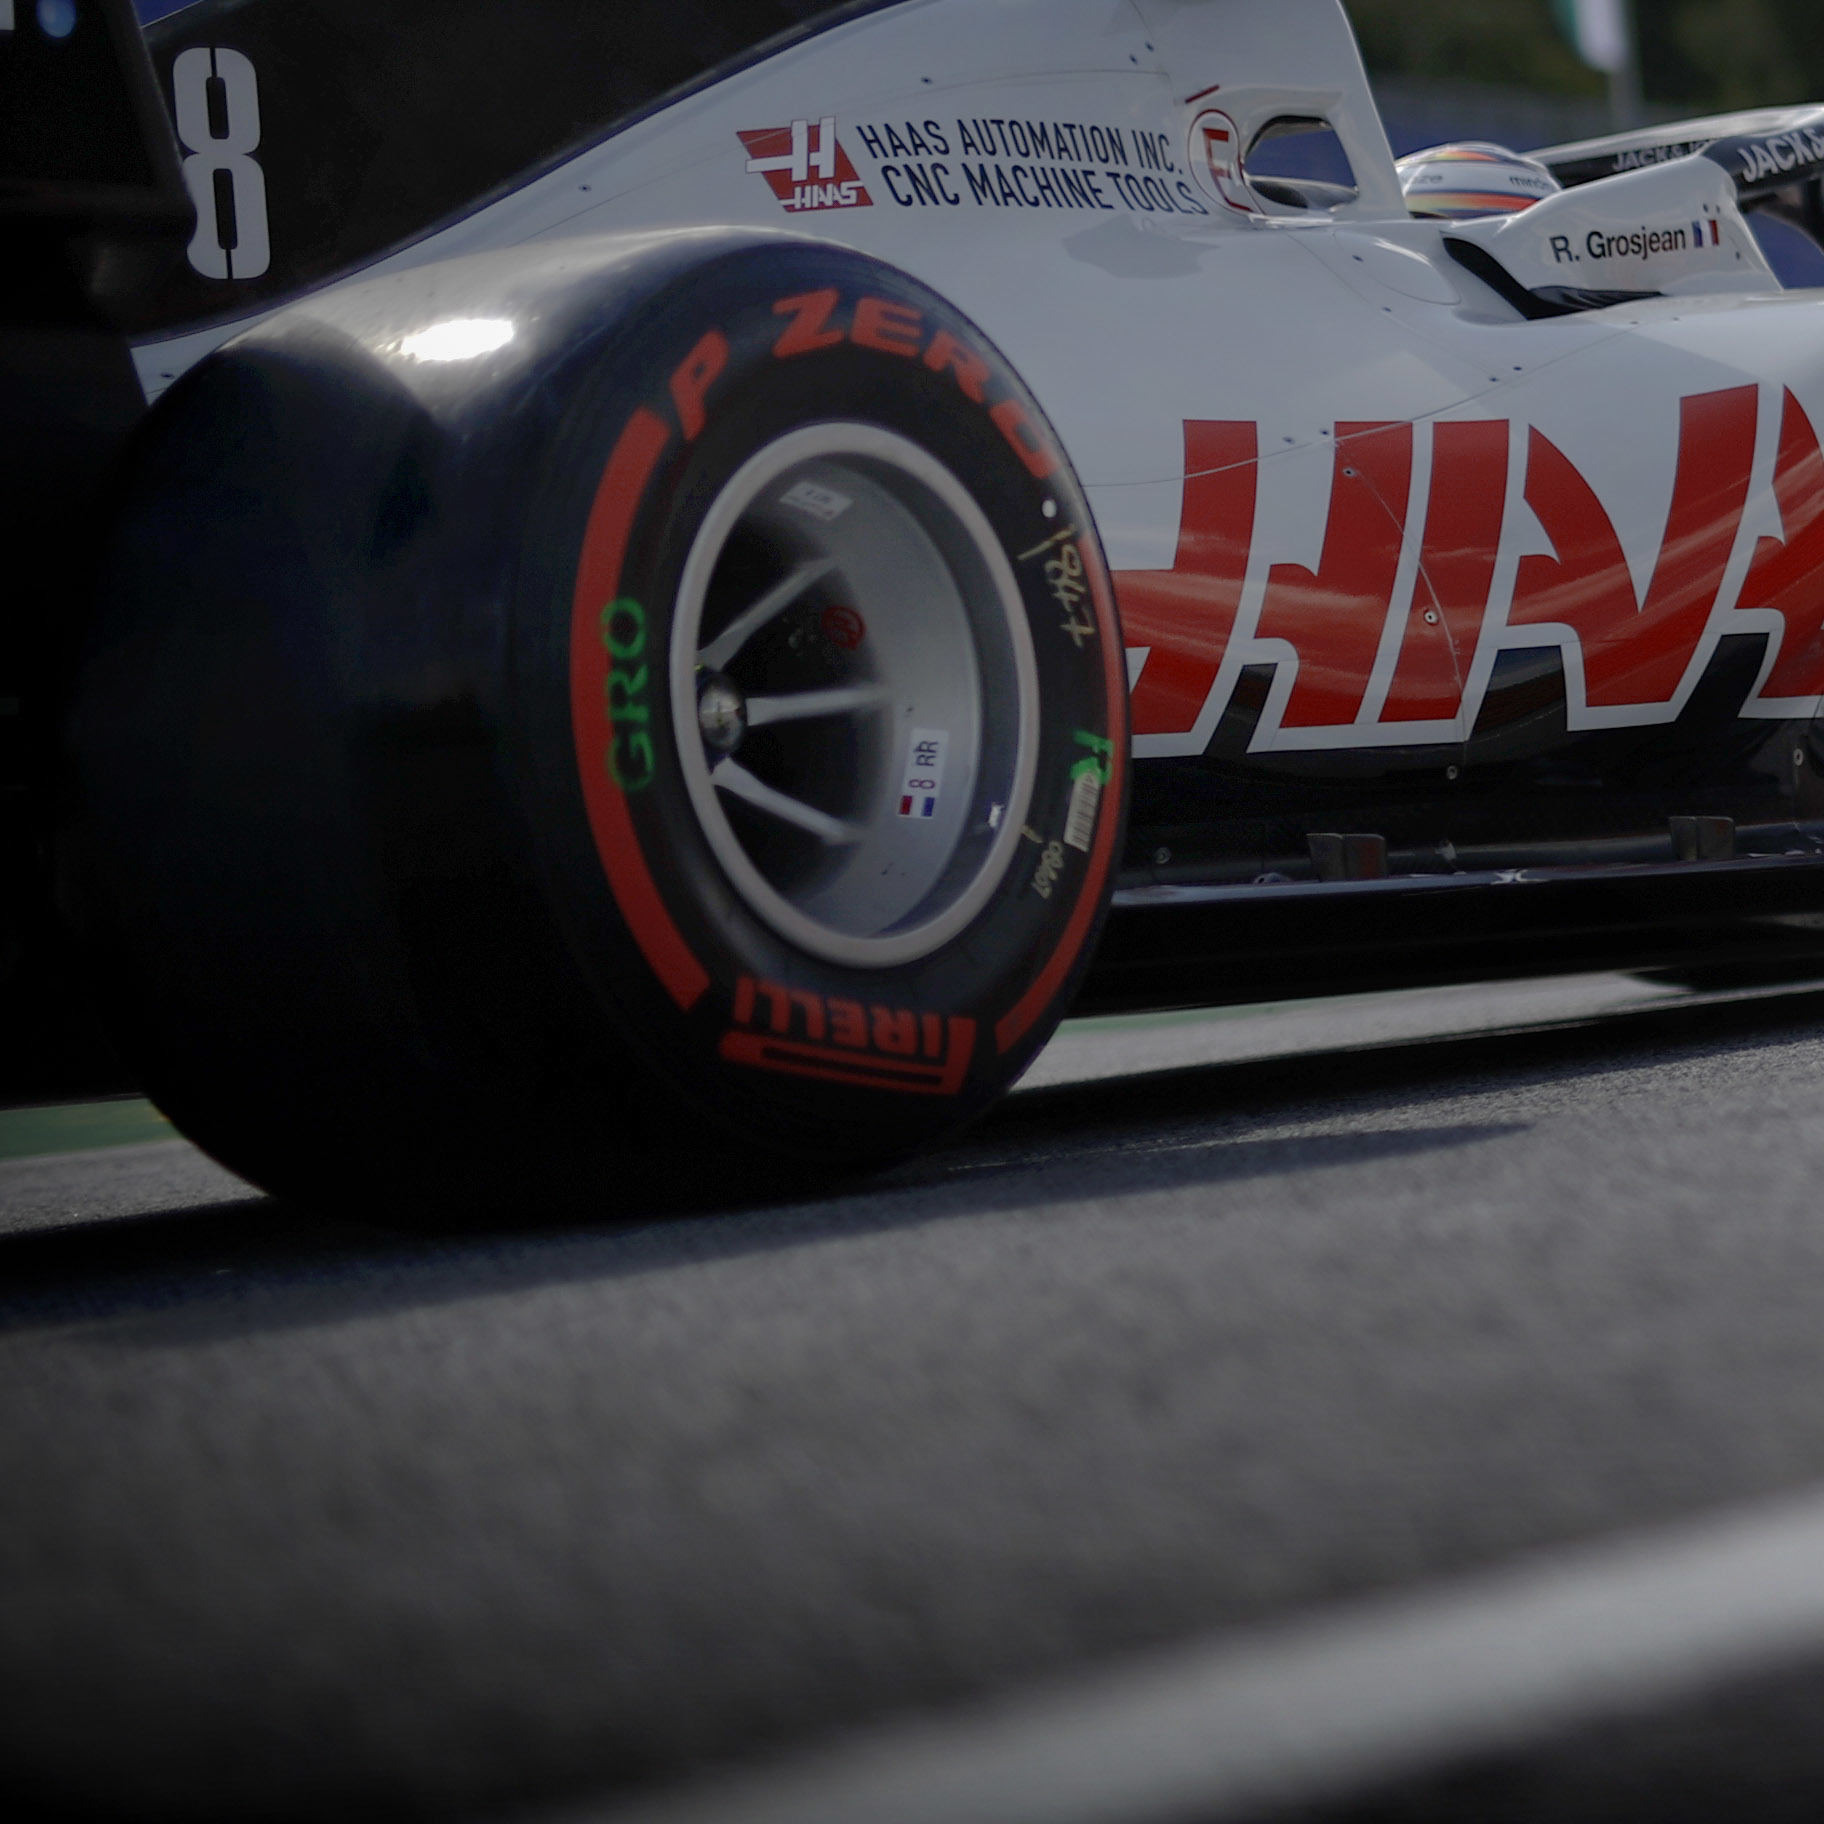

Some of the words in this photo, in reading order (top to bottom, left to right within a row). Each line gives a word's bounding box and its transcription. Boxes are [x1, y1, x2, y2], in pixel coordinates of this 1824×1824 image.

[172, 46, 271, 280] 8
[856, 119, 950, 160] HAAS
[956, 119, 1127, 165] AUTOMATION
[1131, 130, 1185, 175] INC.
[880, 164, 960, 207] CNC
[965, 162, 1113, 211] MACHINE
[1106, 172, 1209, 216] TOOLS
[778, 180, 865, 209] HAAS
[1549, 236, 1579, 264] R.
[1586, 227, 1686, 262] Grosjean
[669, 330, 730, 440] P
[772, 287, 1058, 482] ZERO
[603, 597, 654, 792] GRO
[717, 973, 978, 1095] PIRELLI
